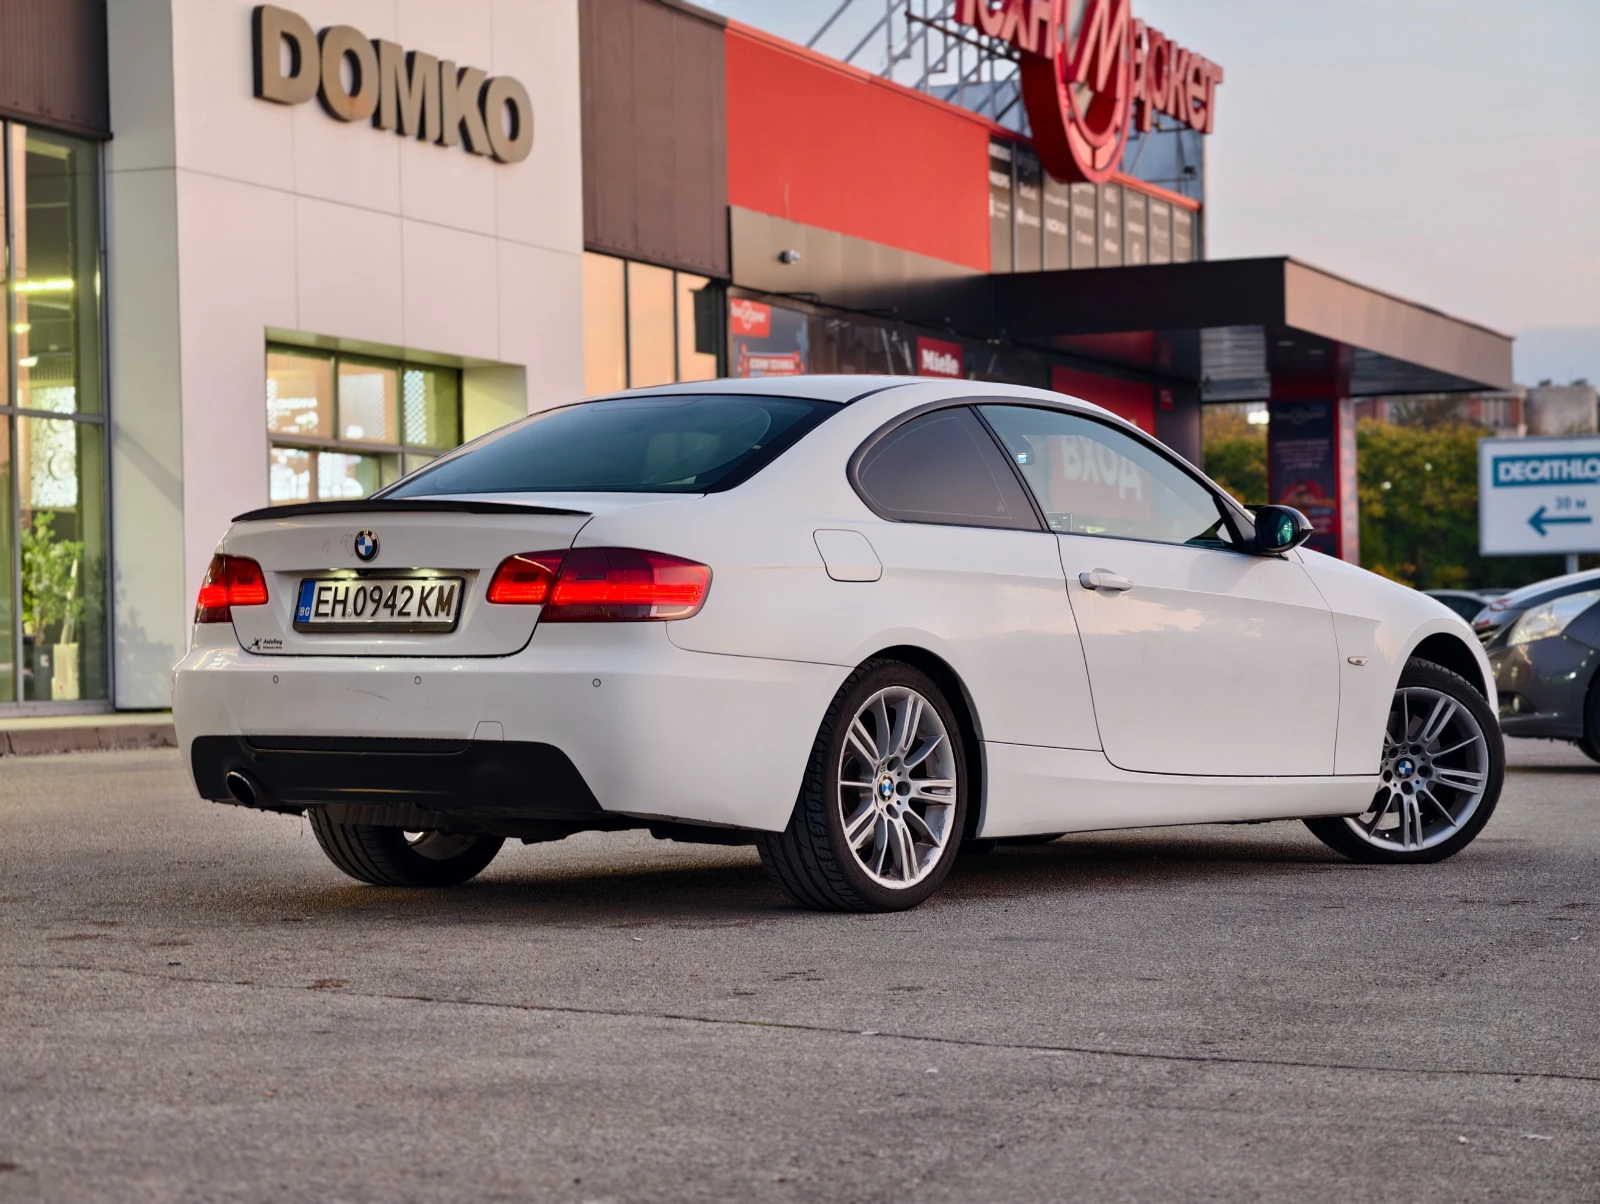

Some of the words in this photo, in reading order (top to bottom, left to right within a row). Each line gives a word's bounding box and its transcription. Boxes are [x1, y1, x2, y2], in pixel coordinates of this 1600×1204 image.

[253, 4, 534, 164] DOMKO
[921, 348, 959, 375] Miele
[299, 606, 310, 617] BG
